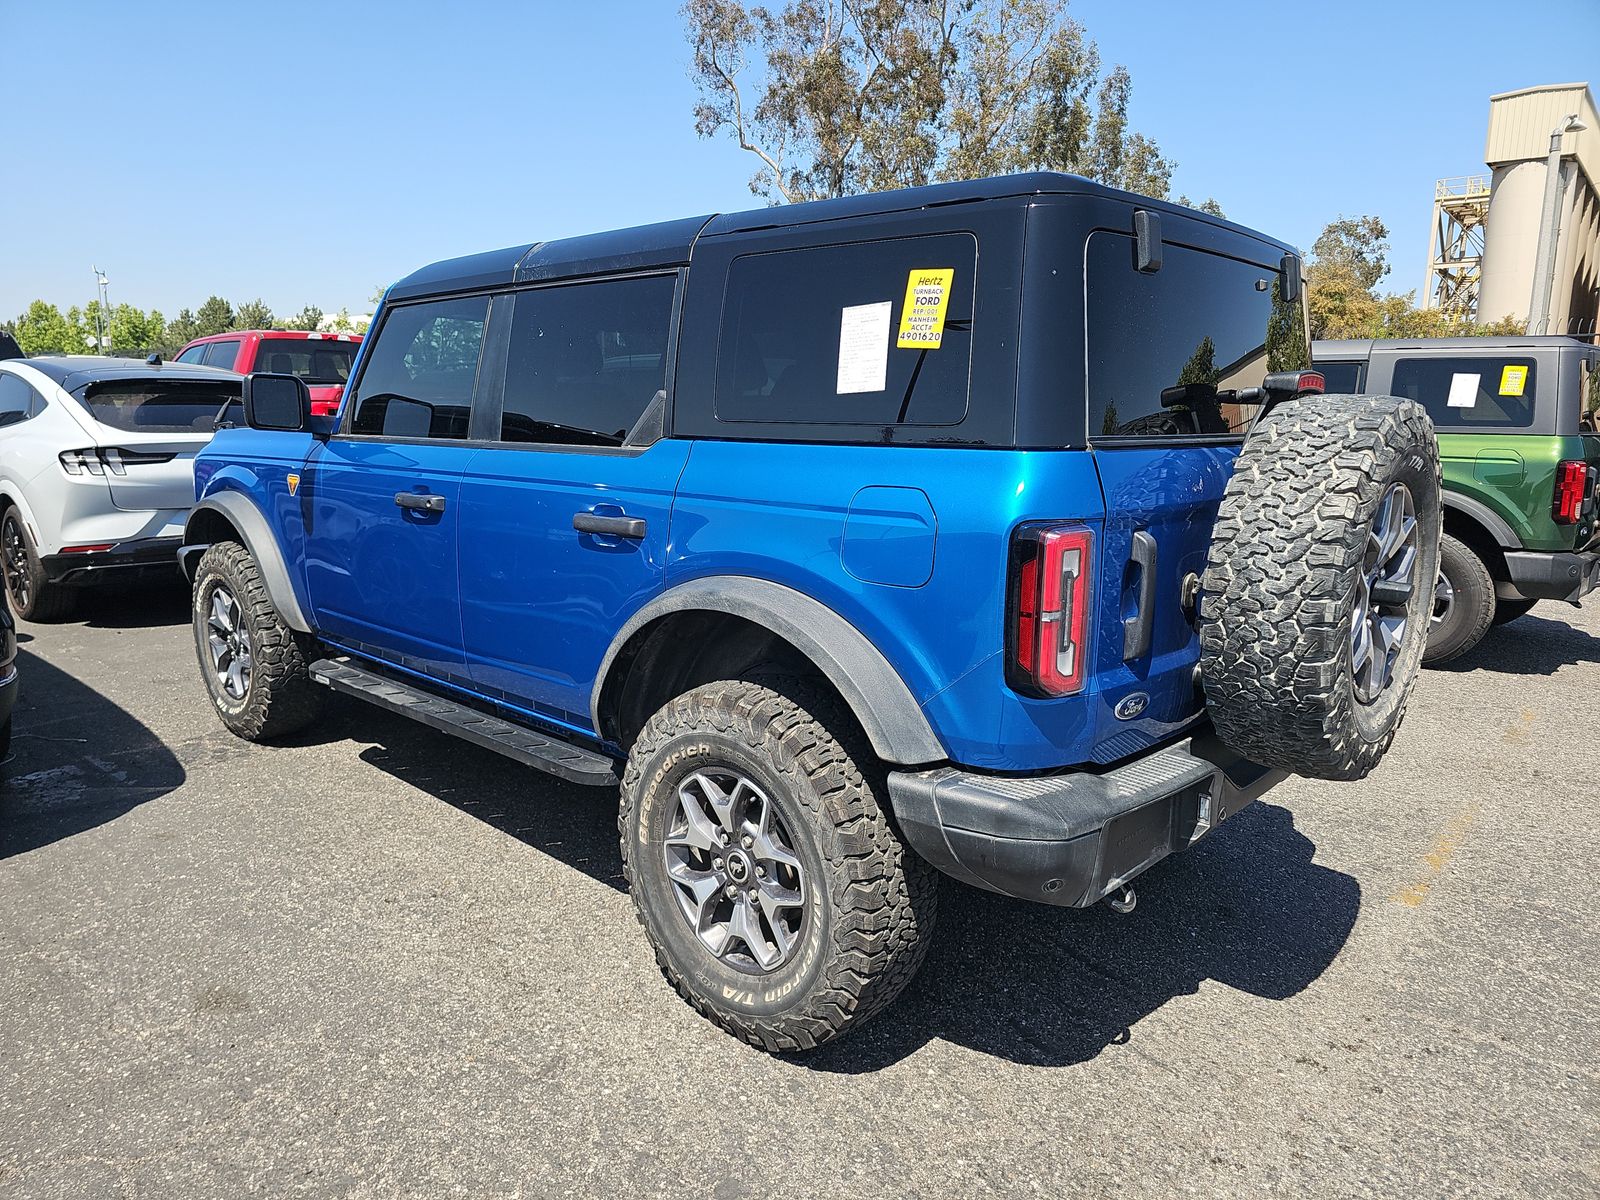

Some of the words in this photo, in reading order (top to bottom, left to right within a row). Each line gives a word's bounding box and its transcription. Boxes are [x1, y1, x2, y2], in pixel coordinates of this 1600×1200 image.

[917, 276, 943, 286] Hertz
[915, 296, 940, 306] FORD
[899, 332, 941, 341] 4901620
[639, 743, 712, 845] BFGoodrich
[722, 985, 755, 1006] T/A
